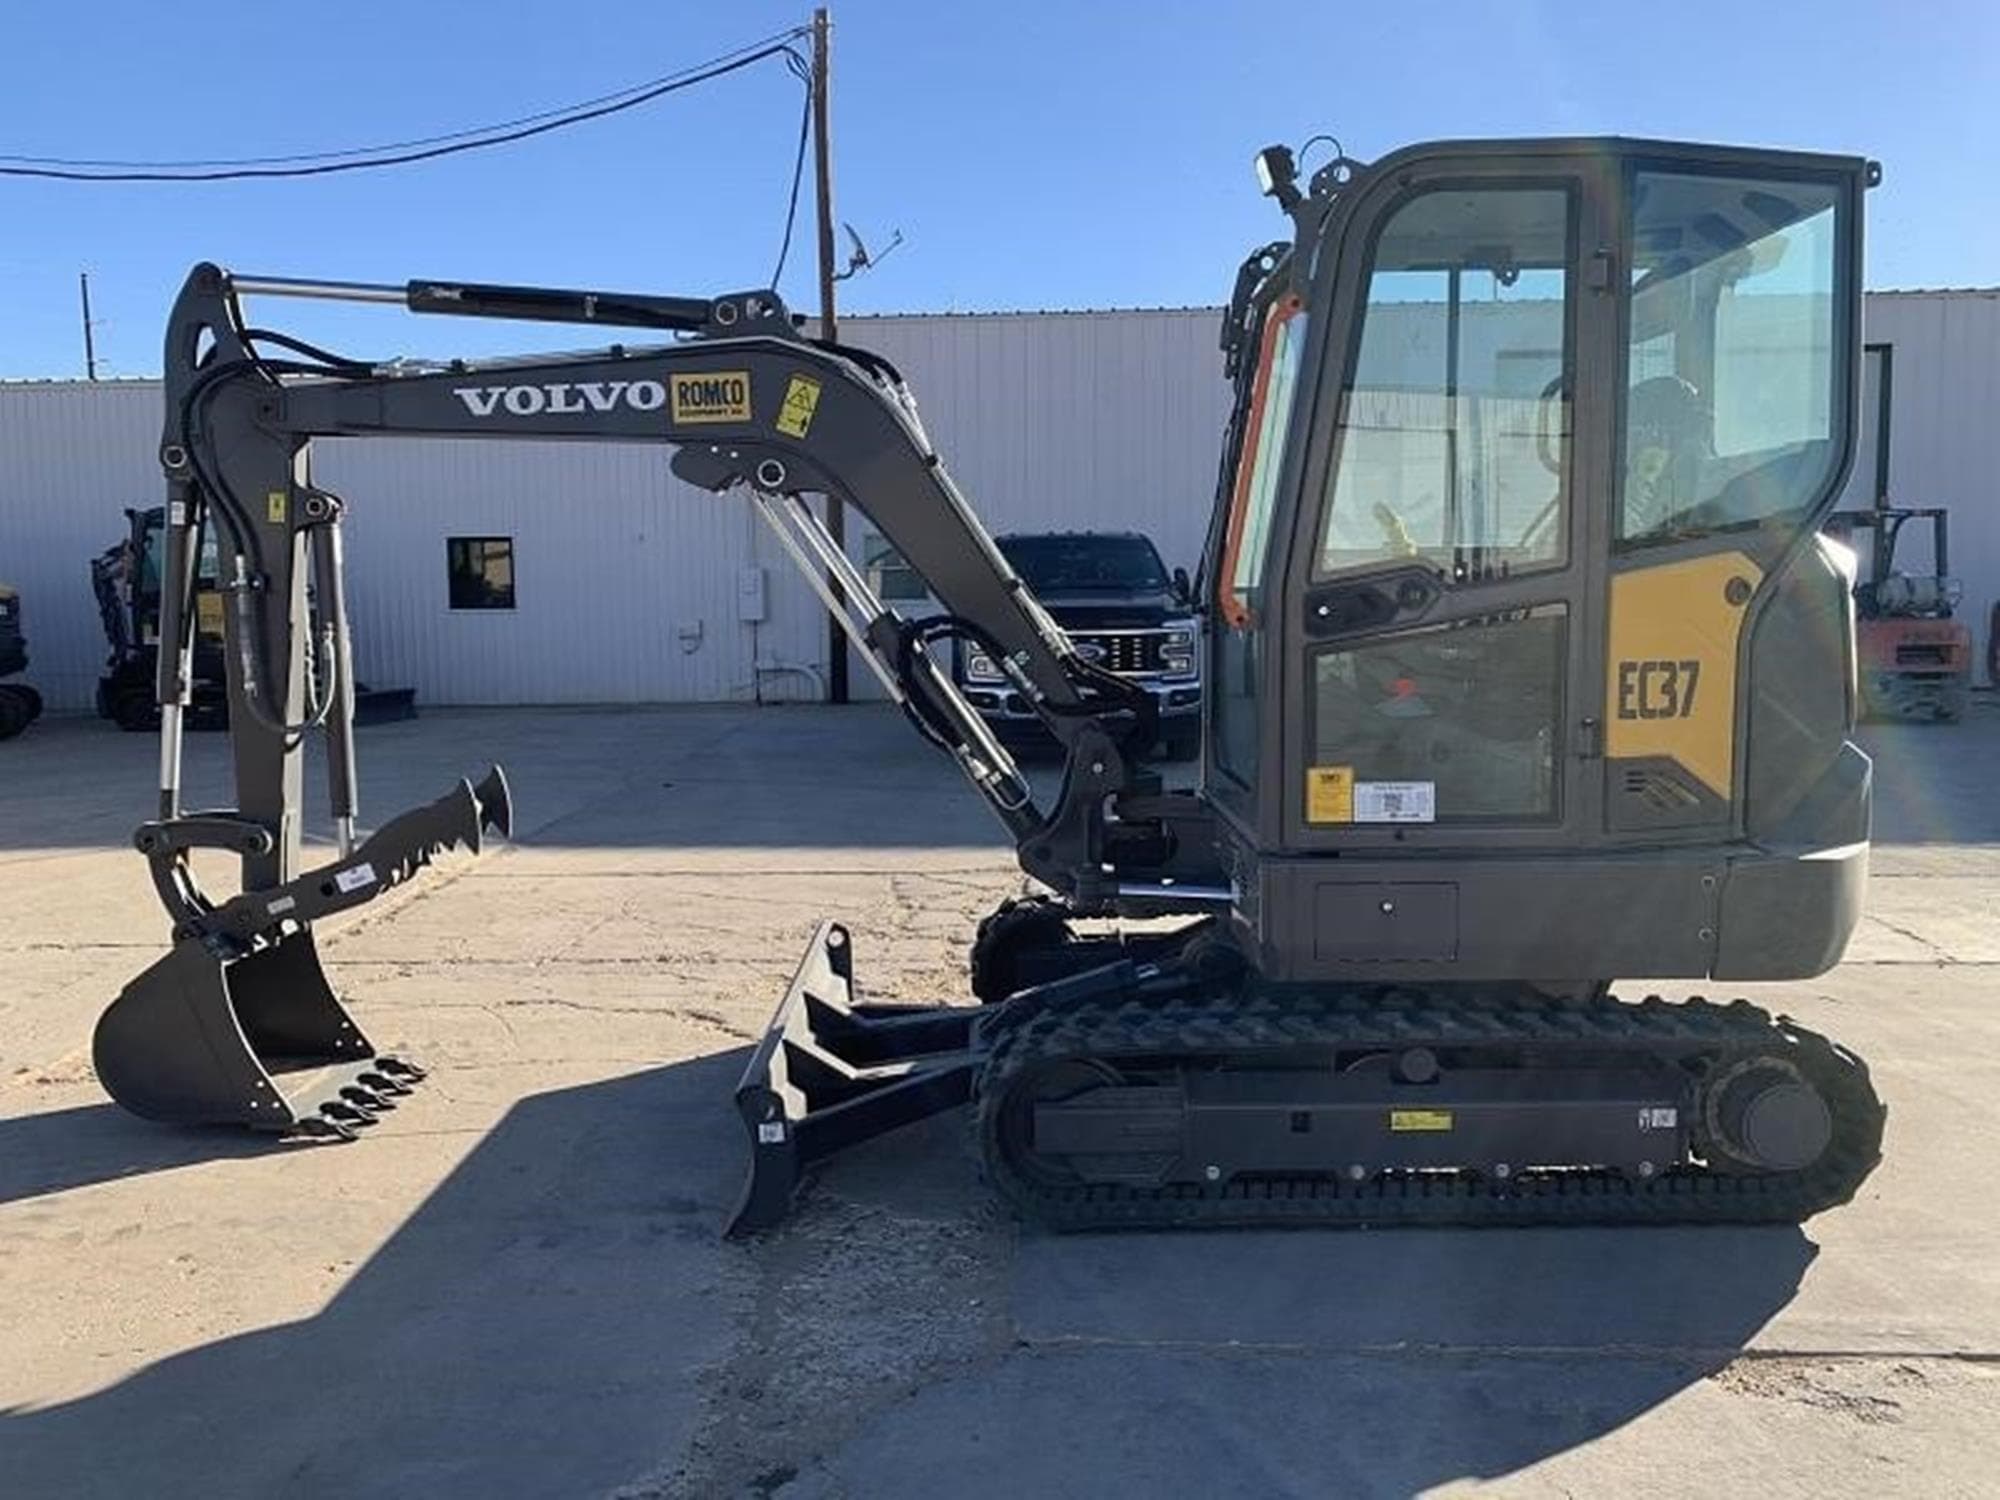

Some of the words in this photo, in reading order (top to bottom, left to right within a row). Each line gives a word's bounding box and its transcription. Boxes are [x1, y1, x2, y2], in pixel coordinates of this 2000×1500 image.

[454, 379, 667, 416] VOLVO
[678, 379, 744, 406] ROMCO
[1615, 661, 1699, 719] EC37
